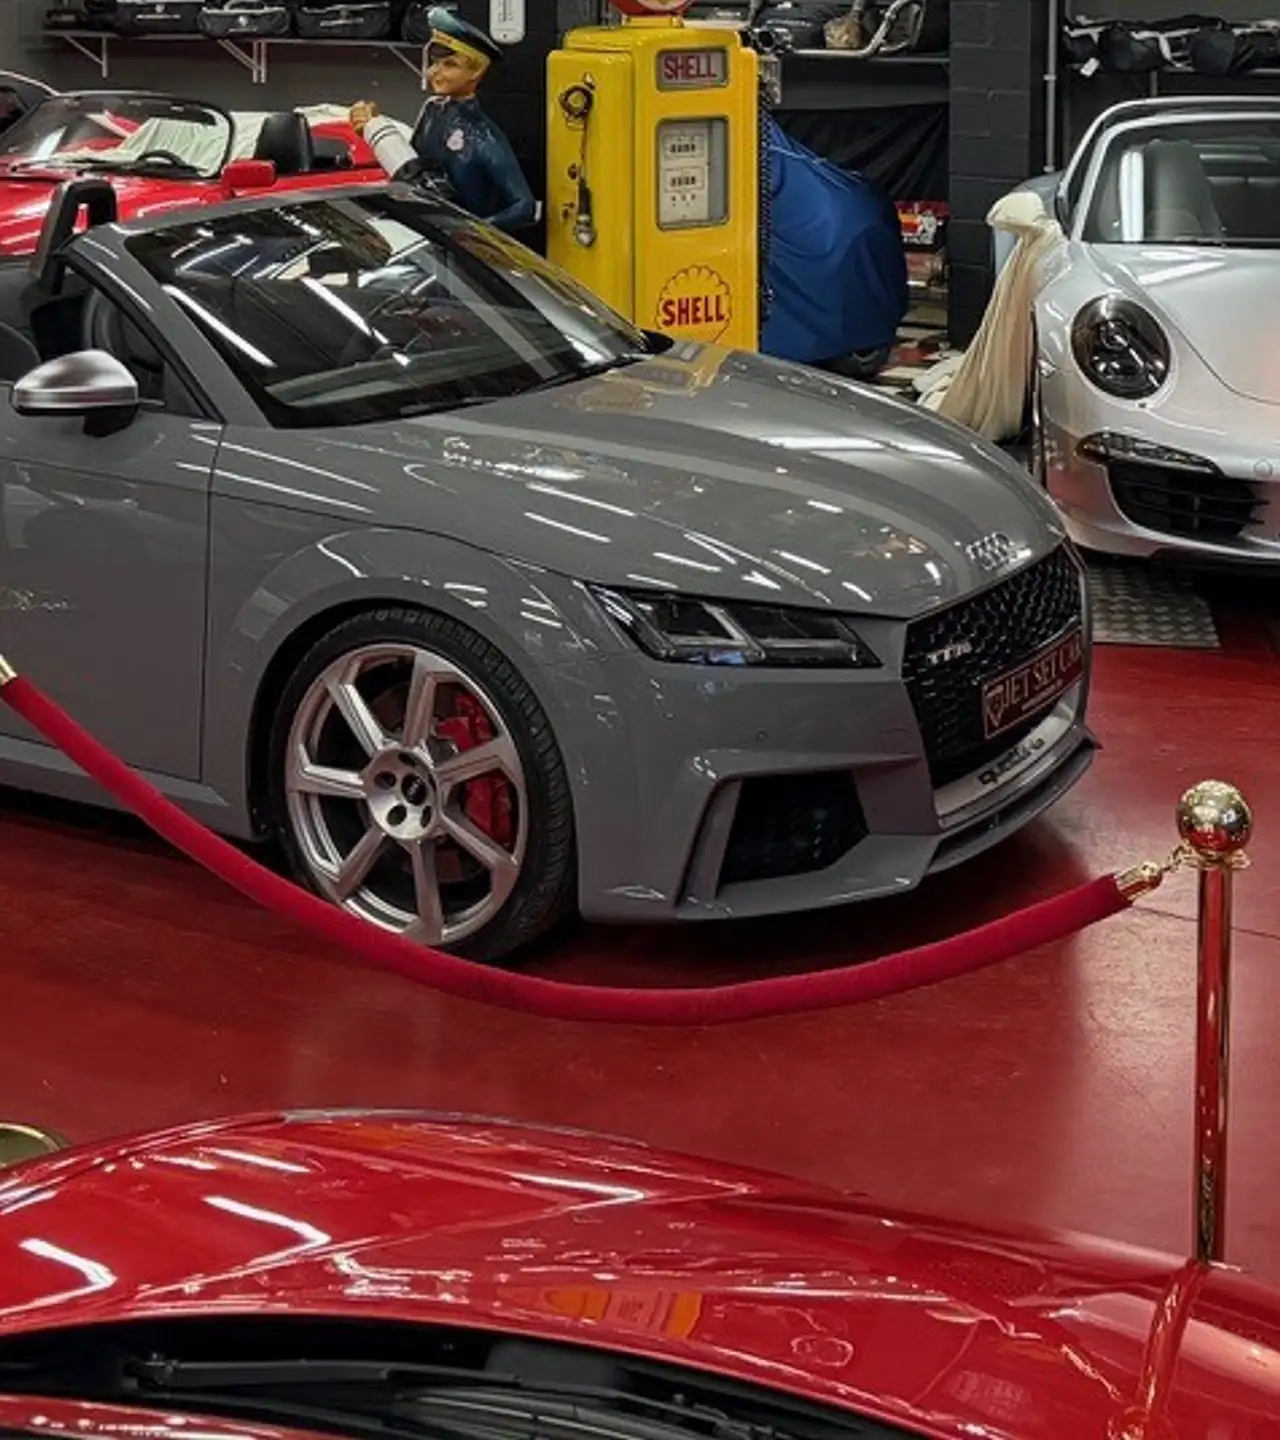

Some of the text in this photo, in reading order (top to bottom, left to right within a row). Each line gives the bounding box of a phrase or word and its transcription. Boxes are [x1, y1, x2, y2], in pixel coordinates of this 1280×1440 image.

[663, 54, 718, 81] SHELL
[661, 294, 725, 327] SHELL
[1004, 667, 1031, 710] JET
[1033, 650, 1057, 691] SET
